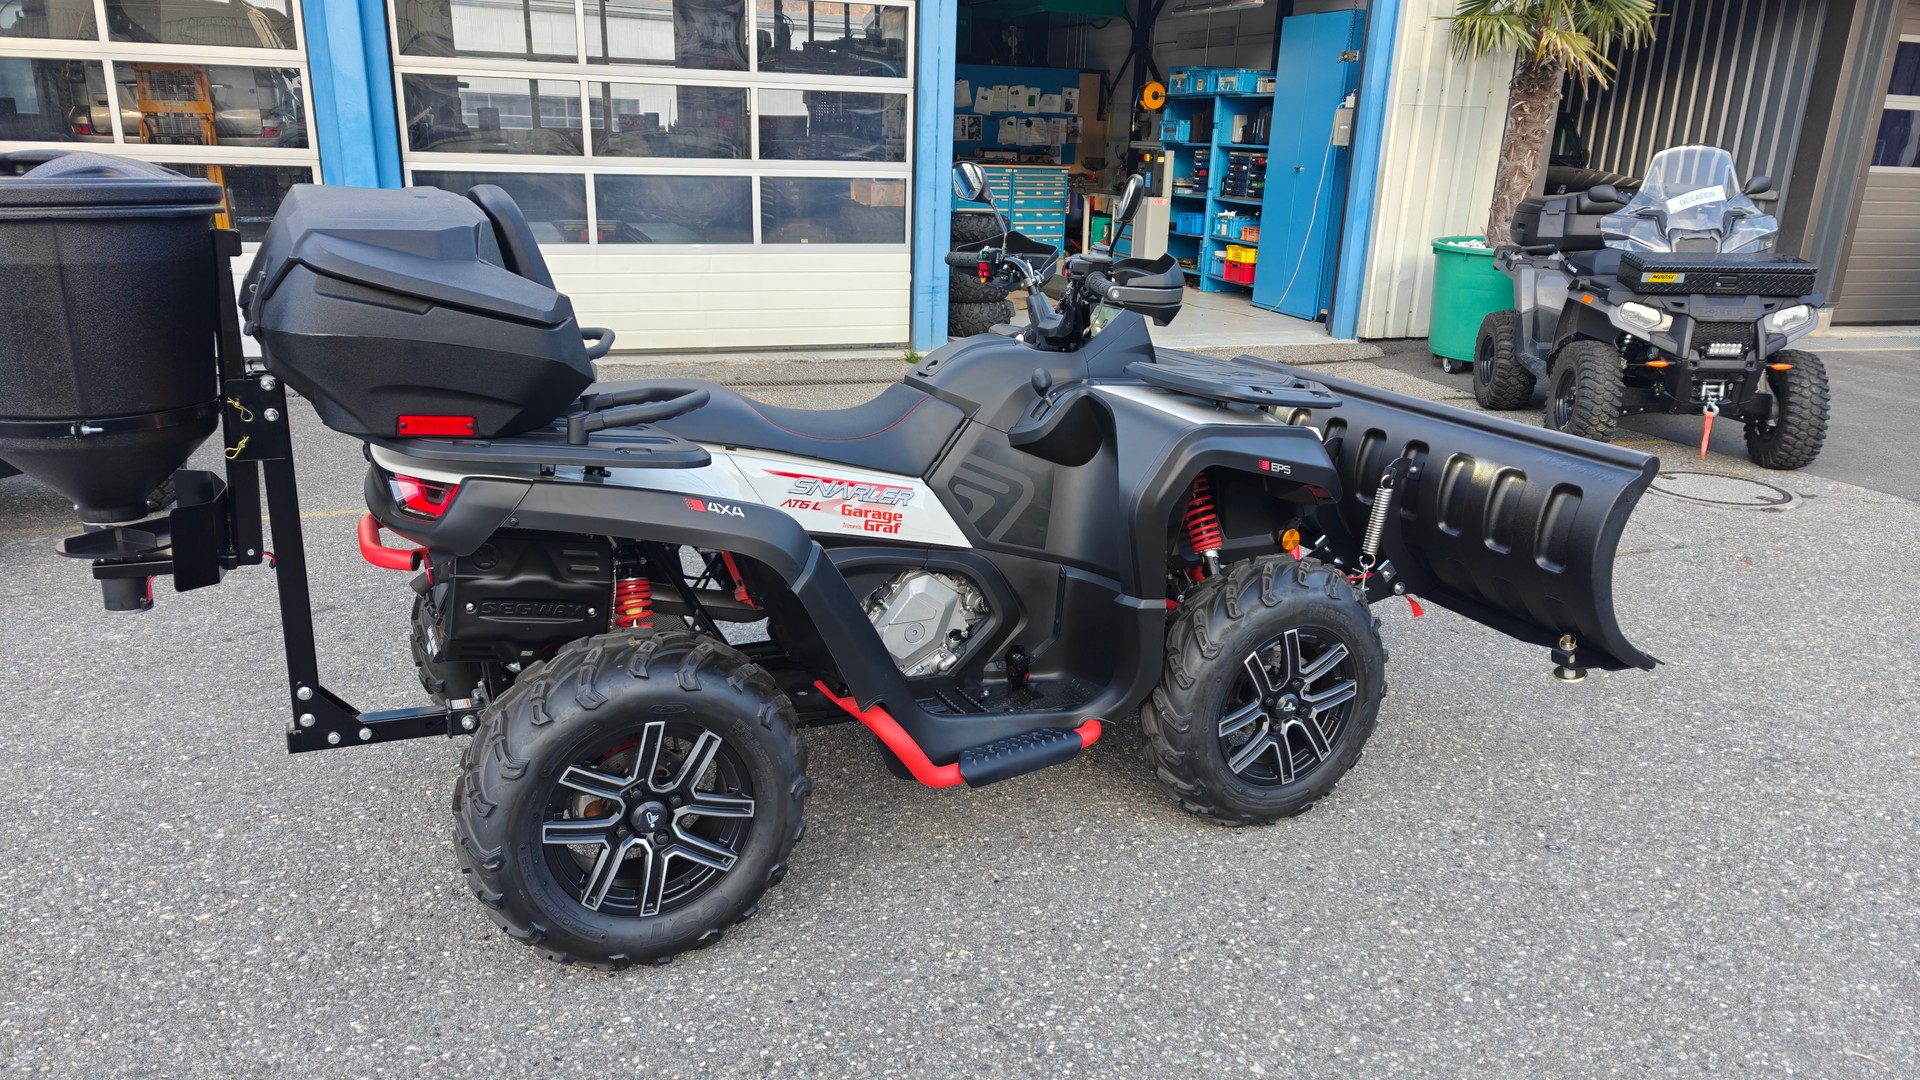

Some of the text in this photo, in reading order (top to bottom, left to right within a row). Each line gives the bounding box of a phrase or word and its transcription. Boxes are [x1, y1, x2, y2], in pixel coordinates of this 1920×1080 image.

[1679, 190, 1717, 206] OCCASION
[1271, 462, 1292, 475] EPS
[788, 476, 915, 507] SNARLER
[841, 503, 903, 524] Garage
[863, 519, 903, 535] Graf
[480, 601, 583, 617] SEGWAY
